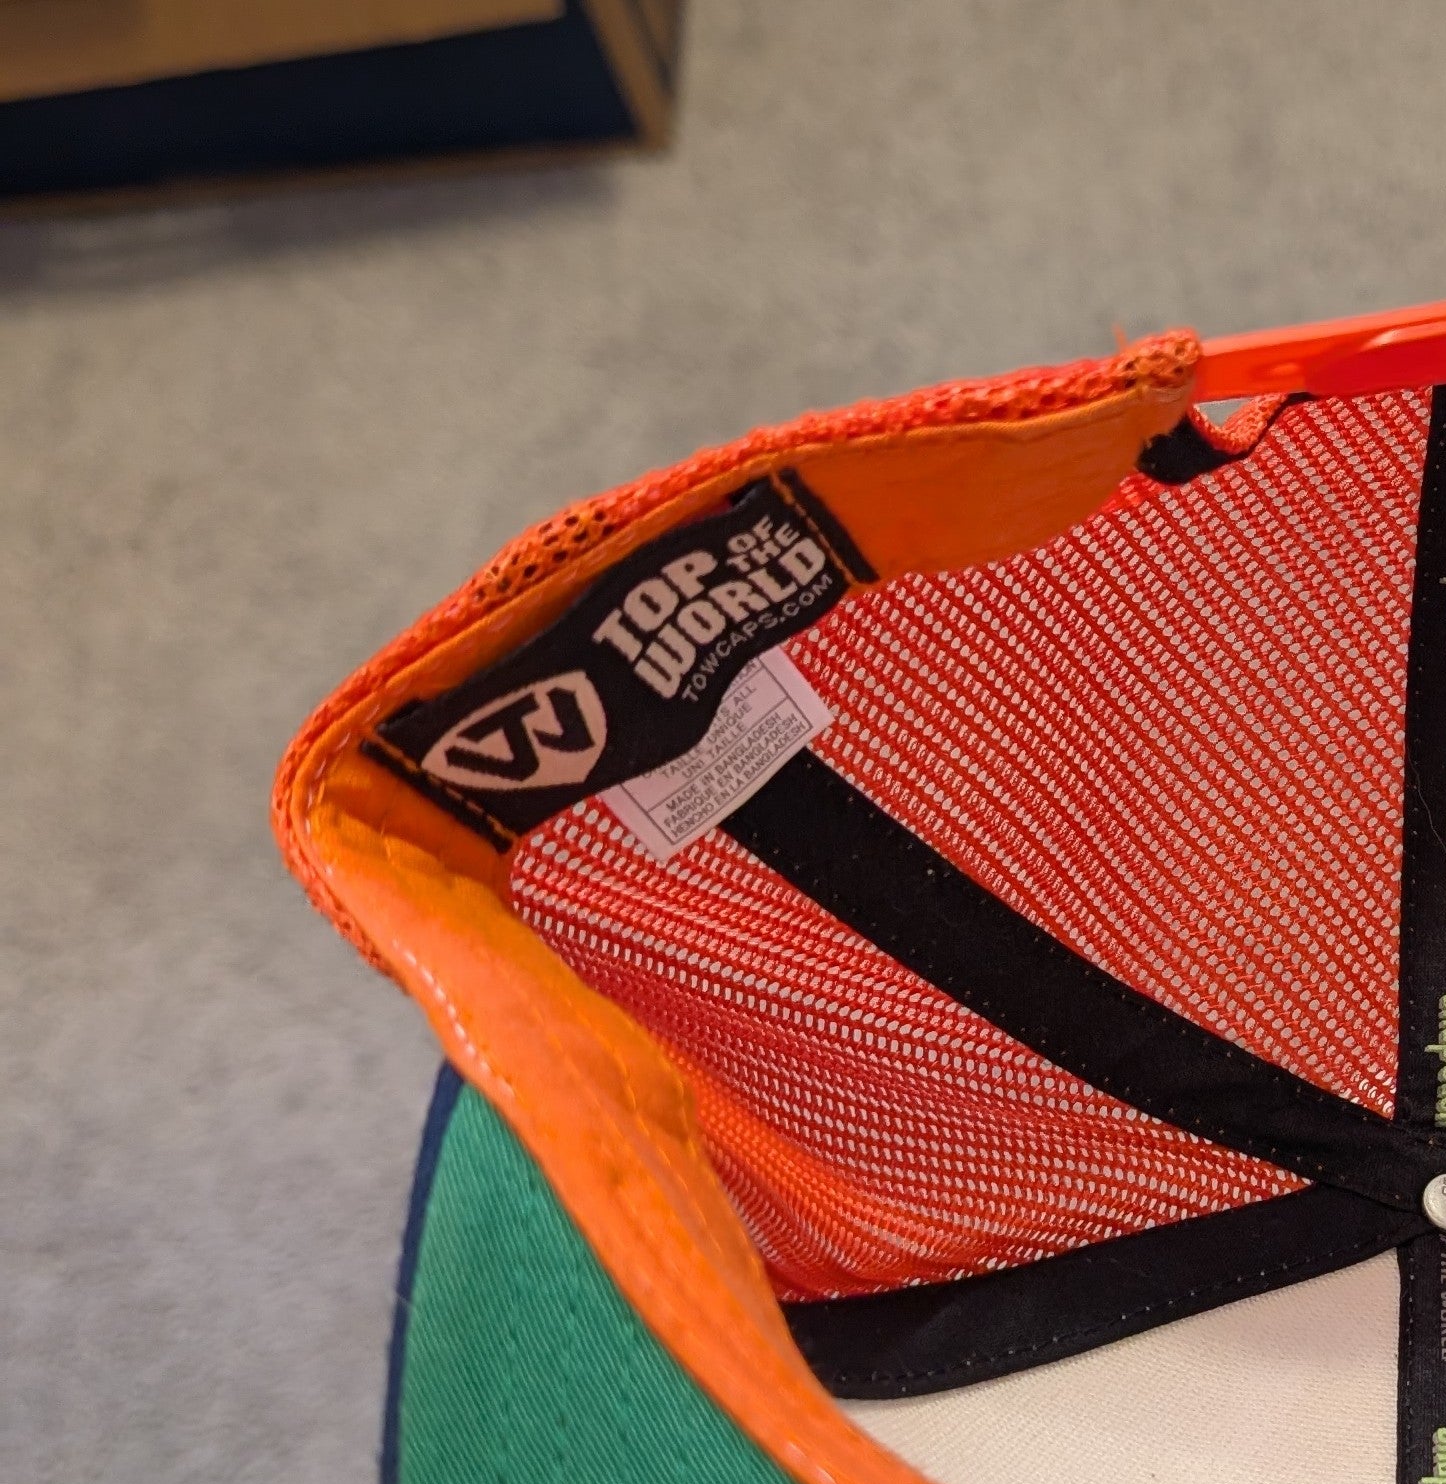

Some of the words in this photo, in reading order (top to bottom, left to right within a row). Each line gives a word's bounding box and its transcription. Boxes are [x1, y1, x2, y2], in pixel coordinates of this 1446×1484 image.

[726, 522, 801, 573] THE
[727, 514, 774, 554] OF
[592, 550, 718, 663] TOP
[633, 537, 826, 699] WORLD
[681, 572, 833, 702] TOWCAPS.COM
[707, 703, 753, 744] UNIQUE
[733, 686, 757, 707] ALL
[663, 788, 716, 829] FABRIQUE
[717, 771, 735, 788] EN
[733, 712, 799, 776] BANGLADESH
[665, 782, 700, 813] MADE
[702, 772, 716, 787] IN
[714, 711, 783, 774] BANGLADESH
[681, 759, 705, 779] UNI
[707, 724, 746, 757] TAILLE
[743, 722, 806, 781] BANGLADESH
